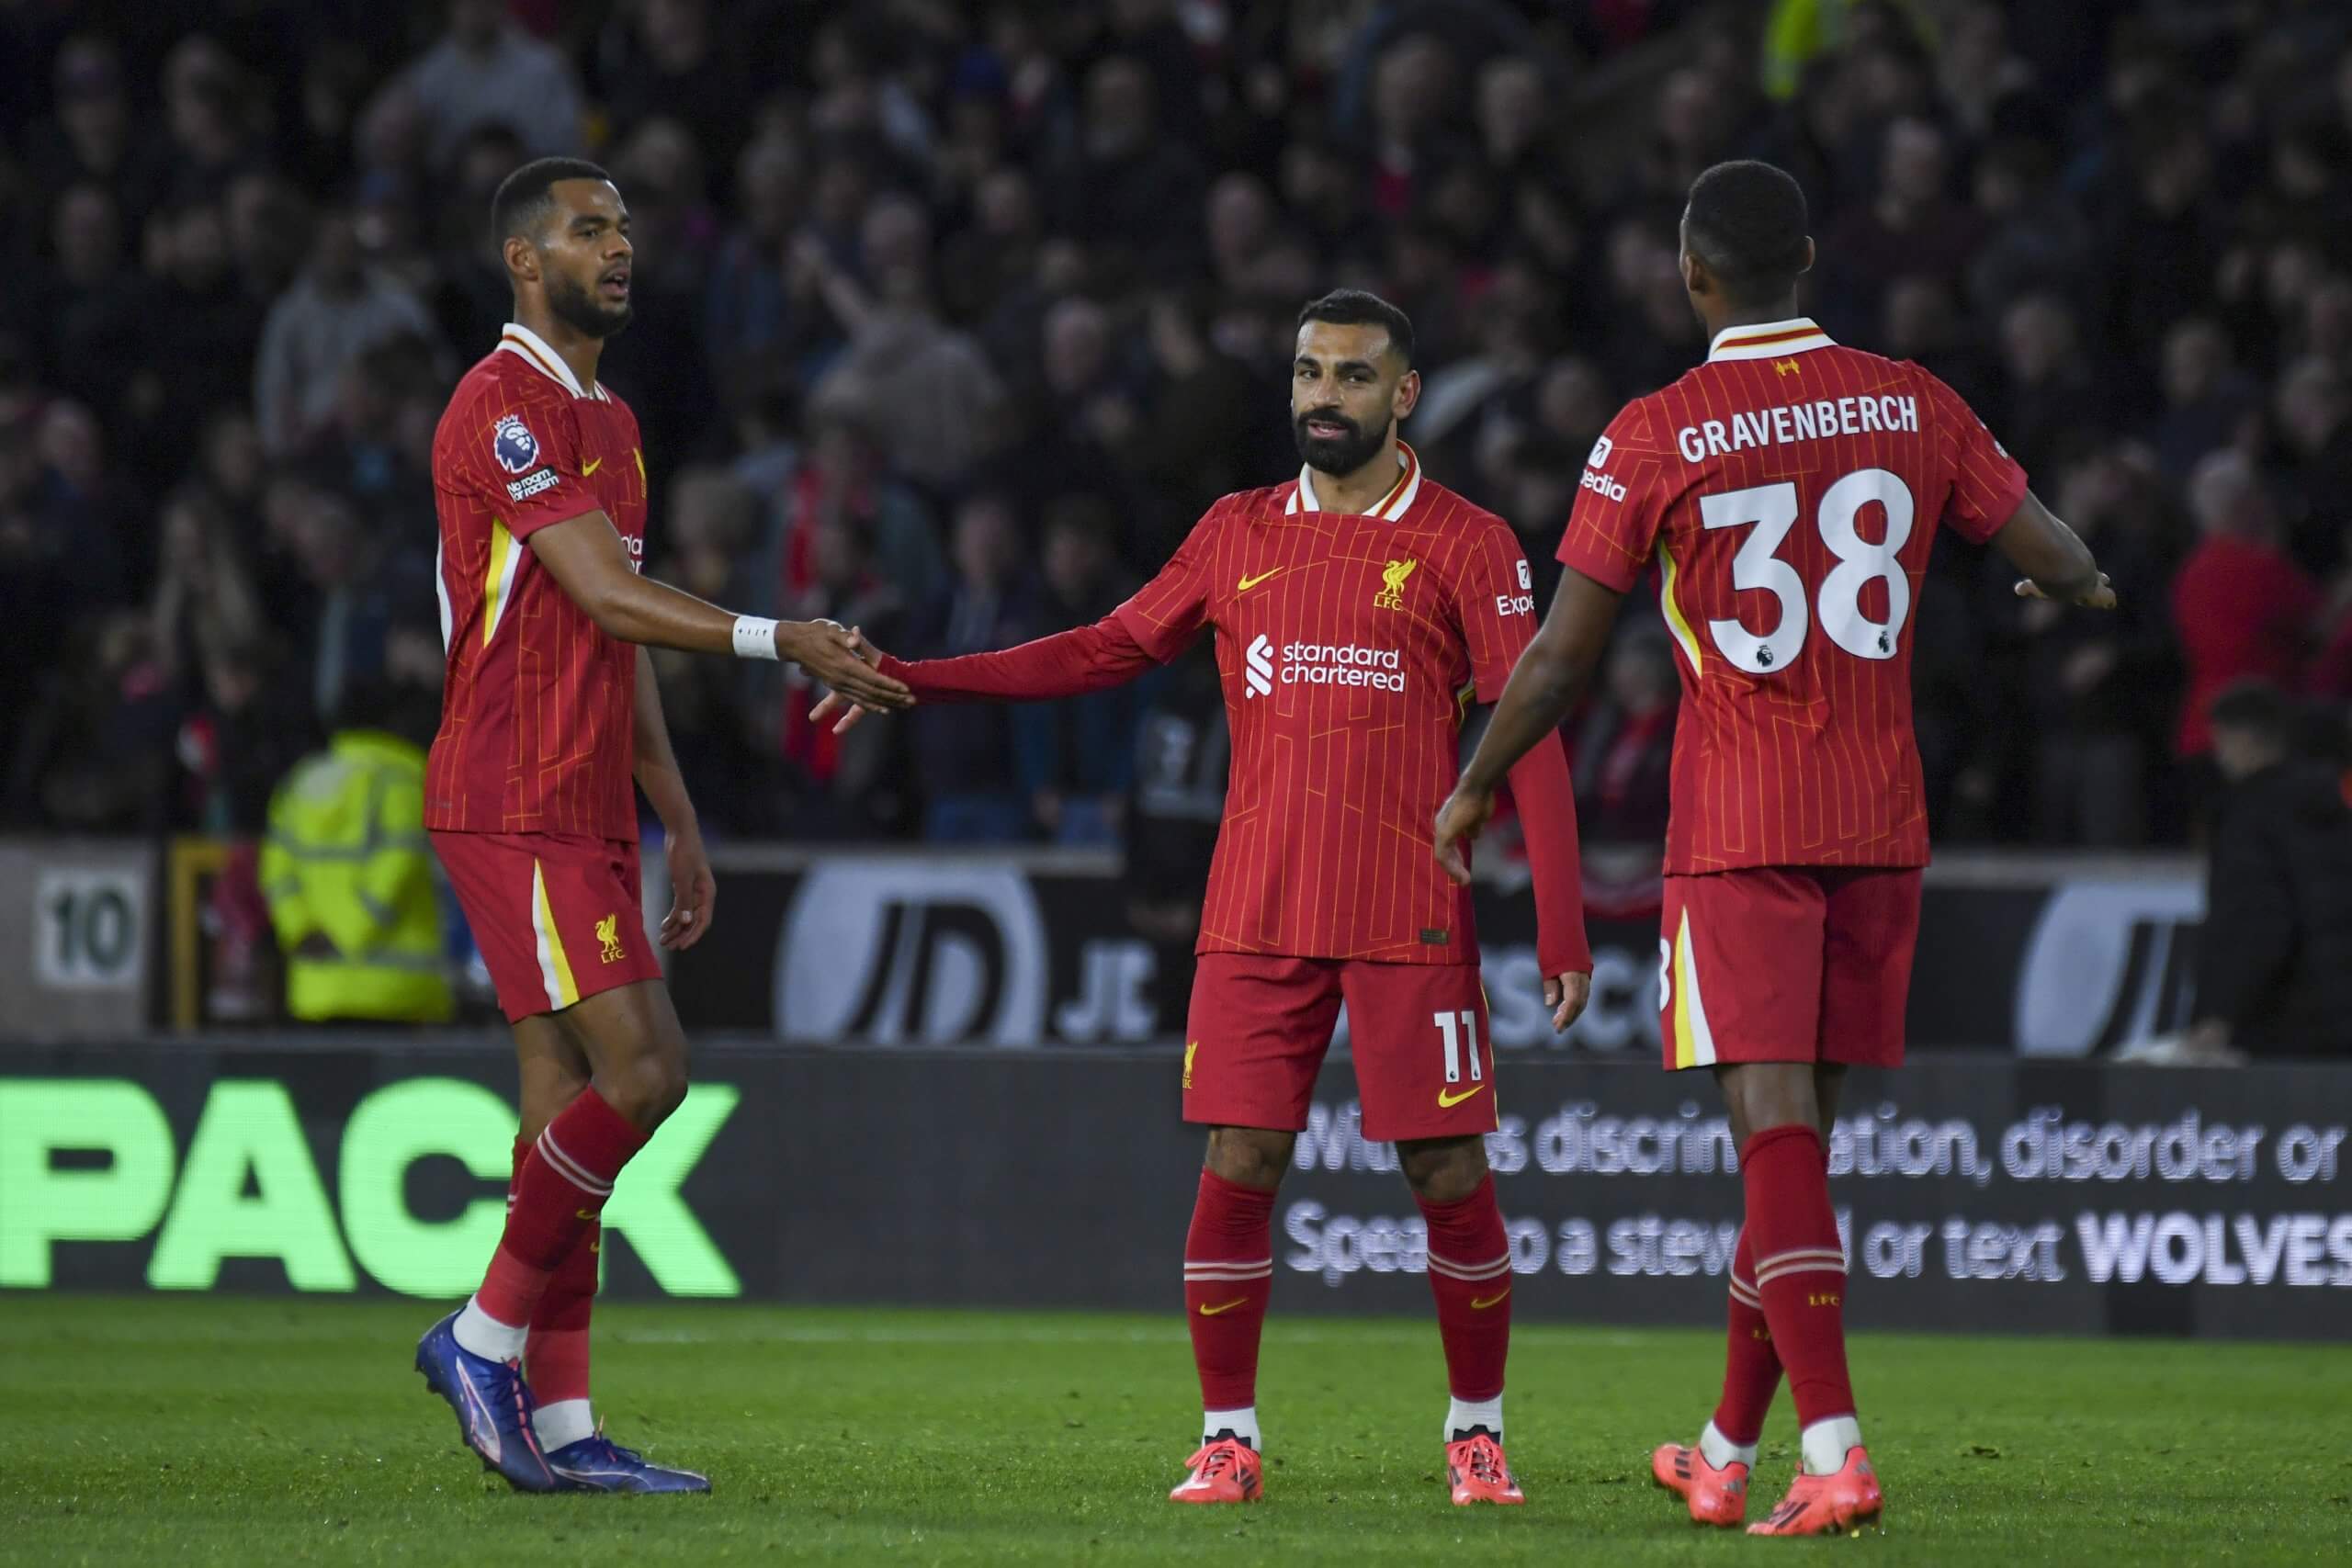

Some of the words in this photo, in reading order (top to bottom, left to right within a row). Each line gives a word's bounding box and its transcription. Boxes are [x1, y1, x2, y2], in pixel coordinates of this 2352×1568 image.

[1679, 395, 1919, 463] GRAVENBERCH
[521, 468, 550, 489] room
[1580, 468, 1627, 502] edia
[1700, 468, 1916, 675] 38
[1281, 662, 1406, 693] chartered
[1282, 640, 1400, 670] standard
[53, 886, 137, 972] 10
[1433, 1010, 1482, 1083] 11
[2000, 1105, 2264, 1181] disorder
[2276, 1123, 2348, 1182] or
[0, 1077, 741, 1300] PACK
[1284, 1199, 1429, 1288] Spea
[1556, 1218, 1599, 1276] a
[1862, 1220, 1932, 1279] or
[1940, 1215, 2067, 1282] text
